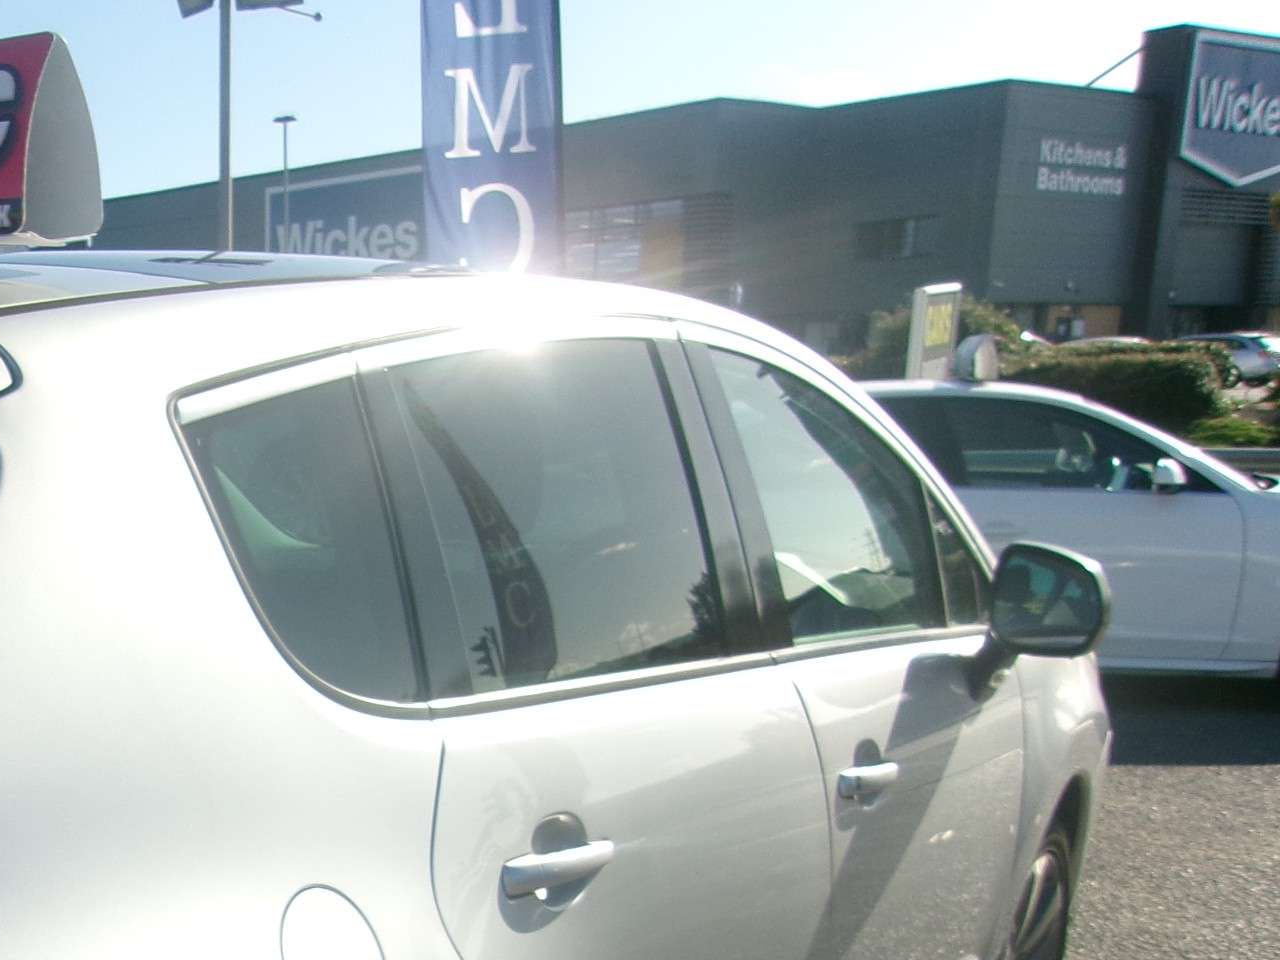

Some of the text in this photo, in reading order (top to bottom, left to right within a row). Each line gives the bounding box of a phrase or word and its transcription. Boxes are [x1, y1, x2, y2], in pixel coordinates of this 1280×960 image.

[1040, 139, 1127, 169] Kitchens &
[1037, 166, 1124, 196] Bathrooms
[276, 215, 419, 260] Wickes
